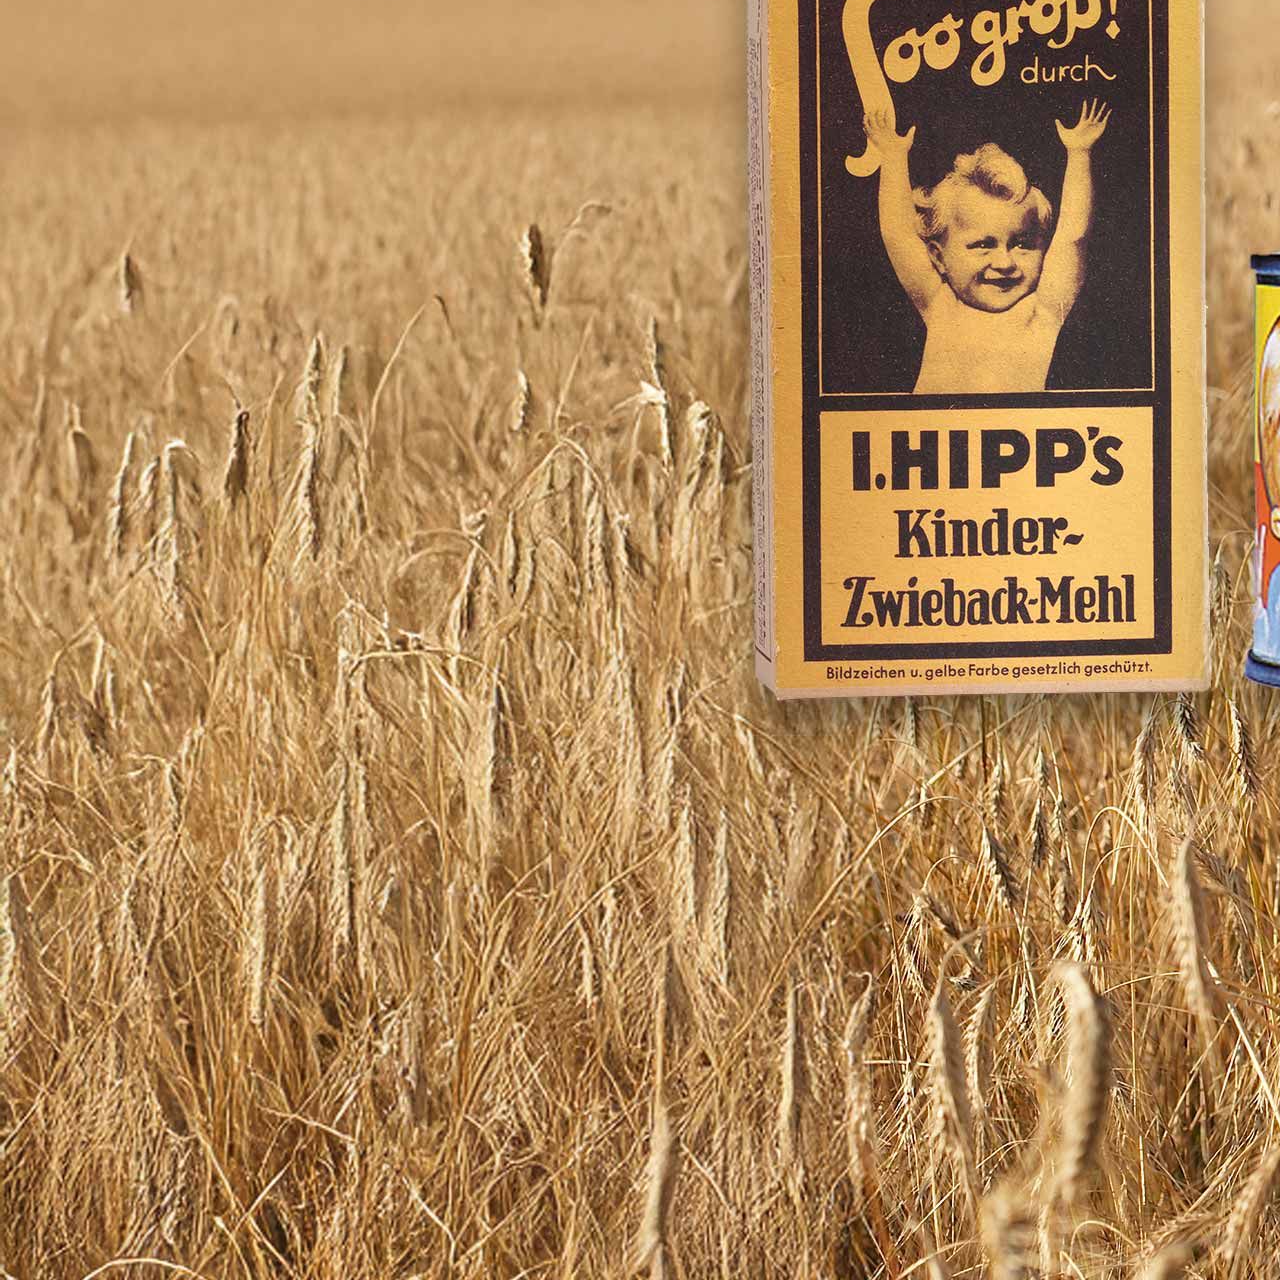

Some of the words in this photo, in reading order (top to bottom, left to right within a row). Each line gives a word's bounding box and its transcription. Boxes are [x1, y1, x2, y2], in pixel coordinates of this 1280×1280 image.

[1021, 55, 1117, 84] durch
[894, 508, 1085, 558] Kinder-
[840, 574, 1137, 628] Zwieback-Mehl
[826, 666, 906, 680] Bildzeichen
[911, 669, 922, 679] u.
[925, 665, 966, 680] gelbe
[968, 663, 1010, 677] Farbe
[1012, 661, 1081, 678] gesetzlich
[1084, 661, 1153, 677] geschützt.
